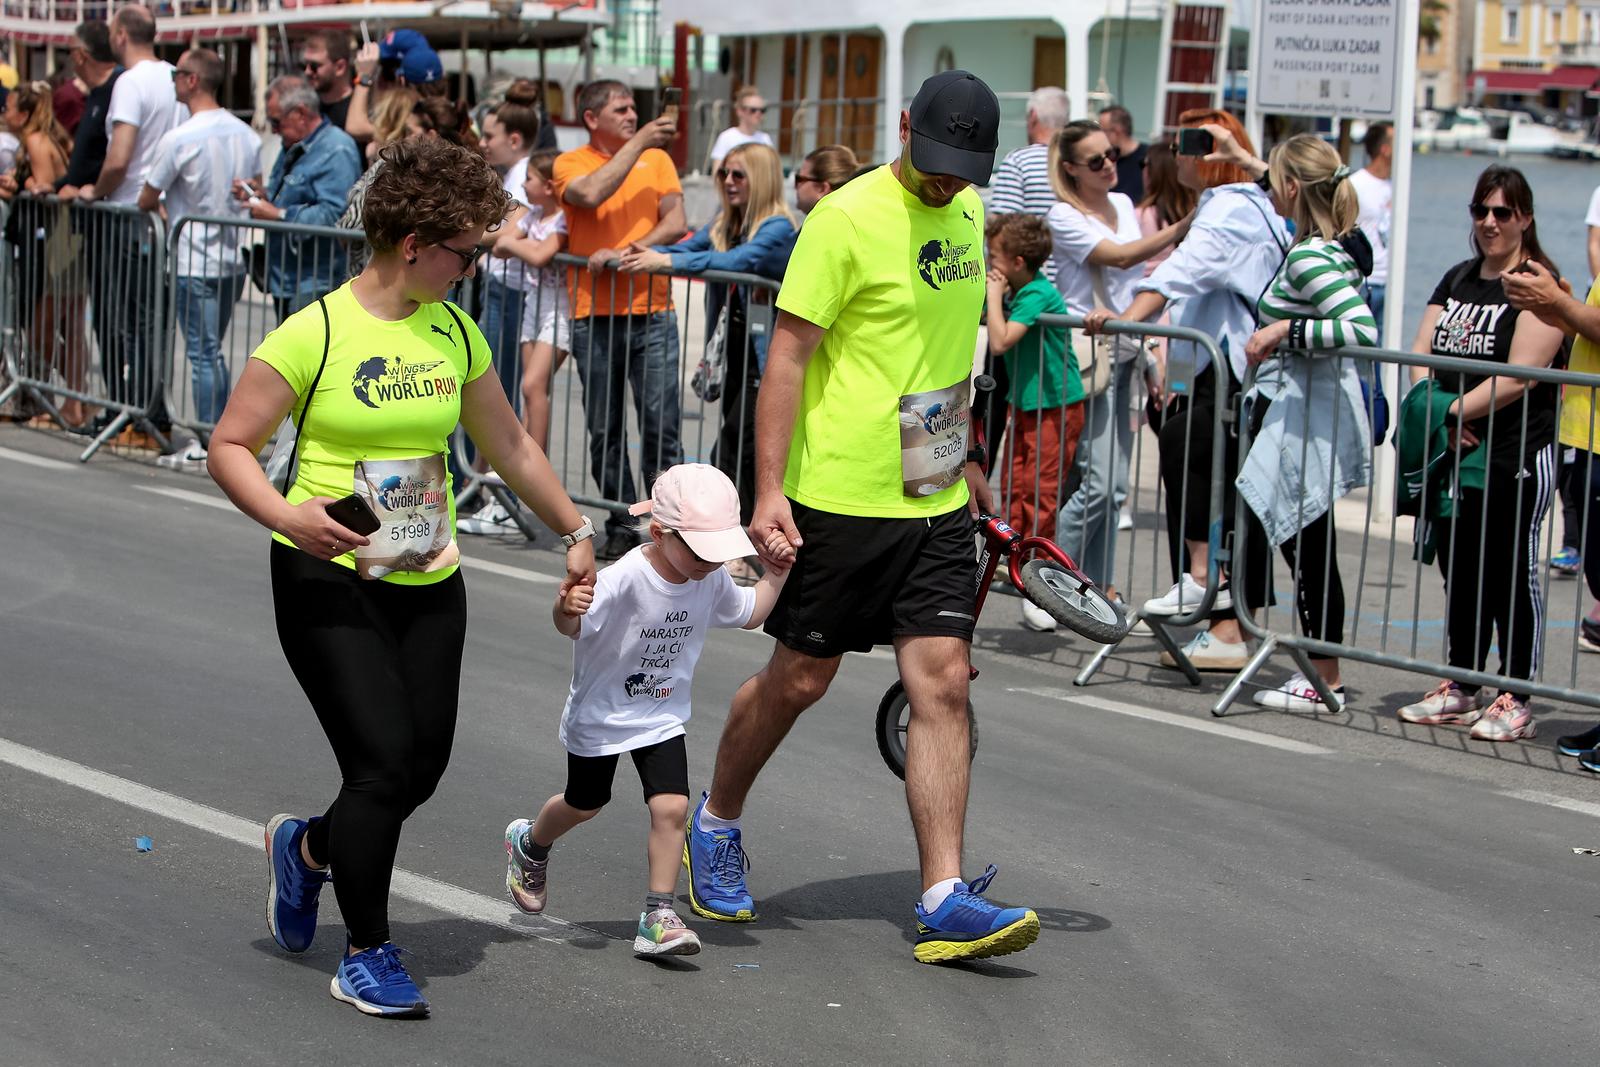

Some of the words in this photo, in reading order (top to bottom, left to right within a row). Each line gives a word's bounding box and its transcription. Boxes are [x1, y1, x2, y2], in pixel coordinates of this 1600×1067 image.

[1268, 12, 1292, 24] PORT
[1294, 12, 1305, 24] OF
[1307, 13, 1335, 25] ZADAR
[1337, 14, 1390, 26] AUTHORITY
[1274, 34, 1320, 52] PUTNIČKA
[1322, 38, 1346, 53] LUKA
[1348, 39, 1380, 55] ZADAR
[1273, 59, 1323, 72] PASSENGER
[1325, 61, 1349, 73] PORT
[1349, 61, 1380, 75] ZADAR
[934, 261, 969, 284] WORLD
[387, 364, 426, 376] WINGS
[395, 373, 417, 383] LIFE
[375, 379, 434, 402] WORLD
[934, 414, 959, 433] WORLD
[933, 439, 962, 460] 52025
[390, 493, 424, 509] WORLD
[424, 490, 441, 505] RUN
[391, 522, 430, 541] 51998
[665, 610, 688, 623] KAD
[645, 643, 651, 654] I
[653, 644, 666, 655] JA
[669, 640, 685, 654] ĆU
